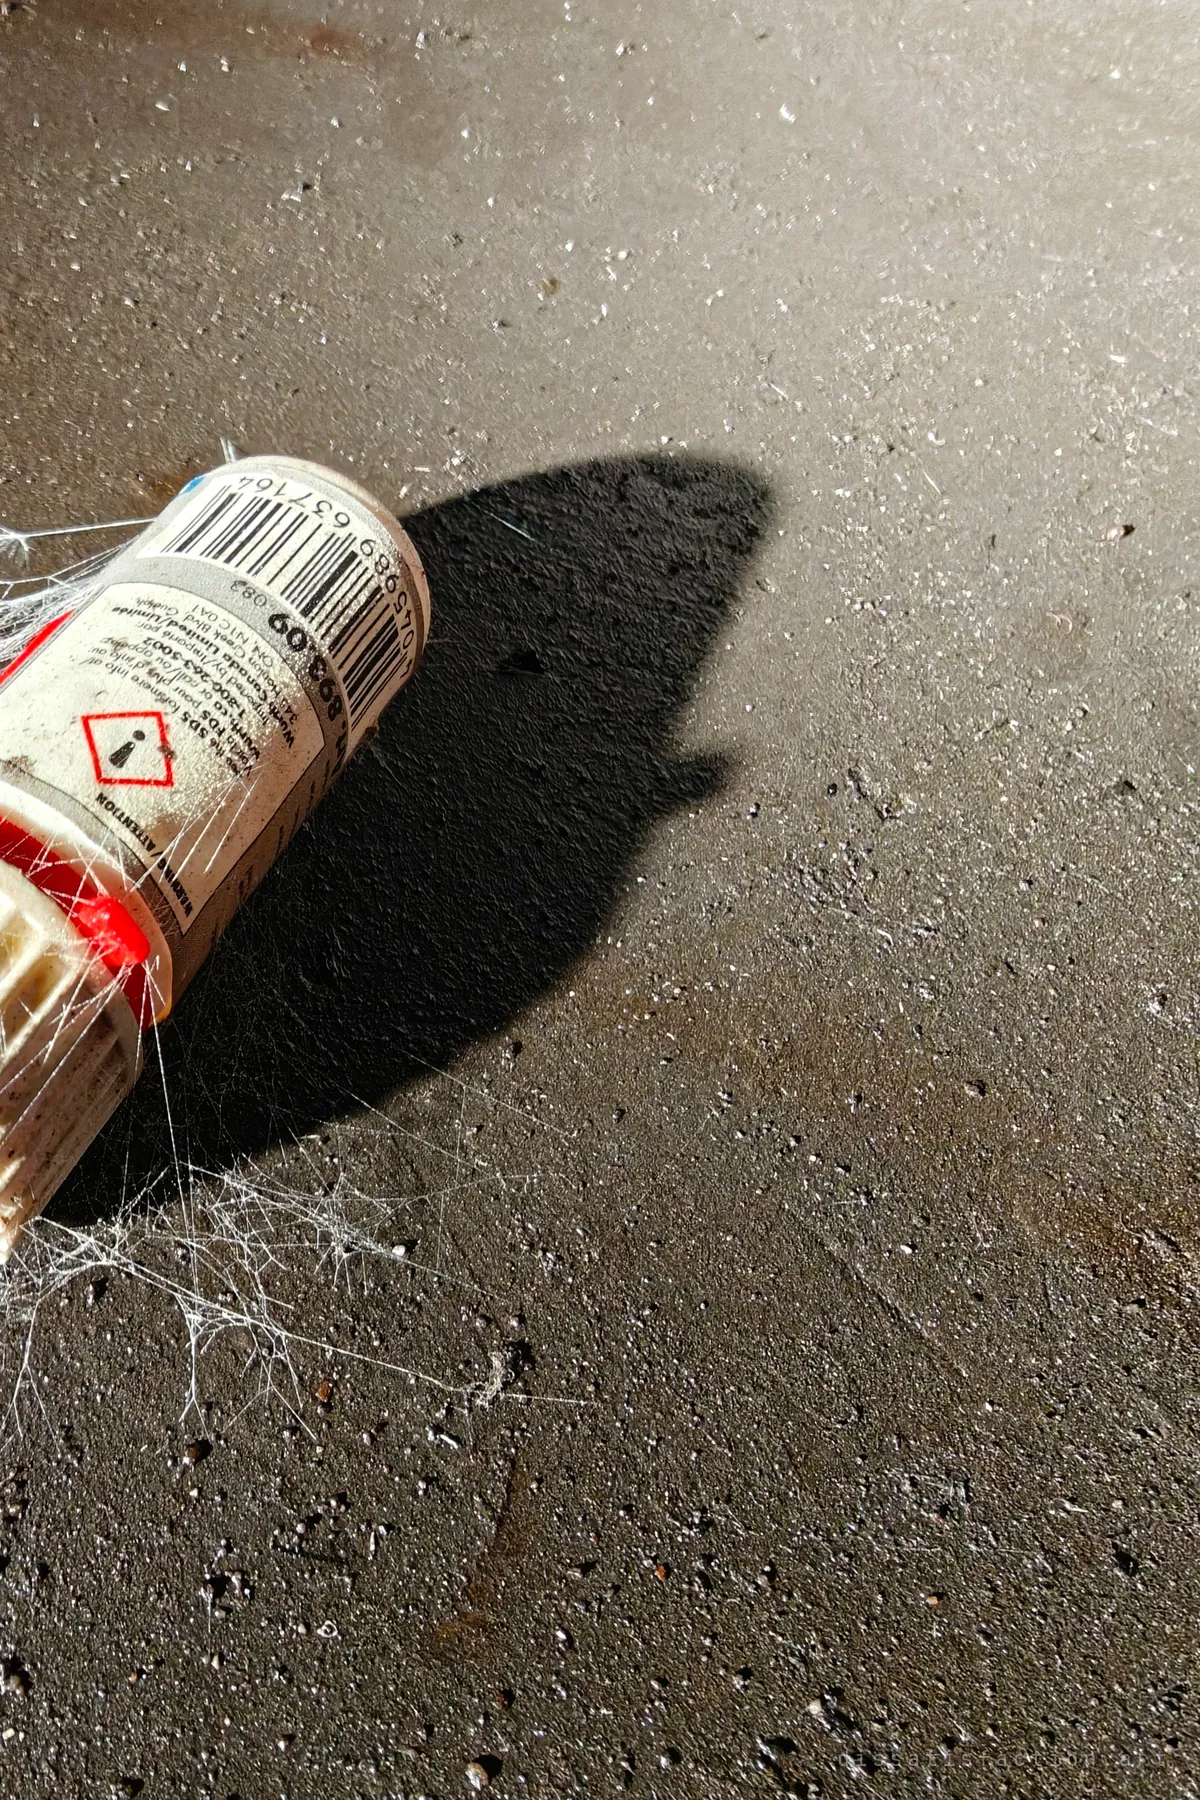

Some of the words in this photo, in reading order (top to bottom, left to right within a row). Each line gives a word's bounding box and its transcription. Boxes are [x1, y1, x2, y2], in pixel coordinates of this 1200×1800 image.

[234, 475, 349, 528] 637164
[229, 578, 268, 607] 083
[357, 536, 416, 647] 045989
[211, 628, 246, 659] Creek
[216, 616, 250, 644] N1C
[251, 641, 275, 668] ON,
[264, 613, 345, 721] 893.09
[398, 659, 412, 678] 4
[103, 660, 129, 679] info
[143, 634, 246, 719] 1-800-263-5002
[145, 665, 179, 686] plus
[220, 651, 268, 702] Canada
[172, 683, 203, 710] pour
[197, 686, 213, 701] or
[224, 675, 270, 725] Imported
[179, 709, 209, 738] SDS
[196, 708, 226, 737] FDS
